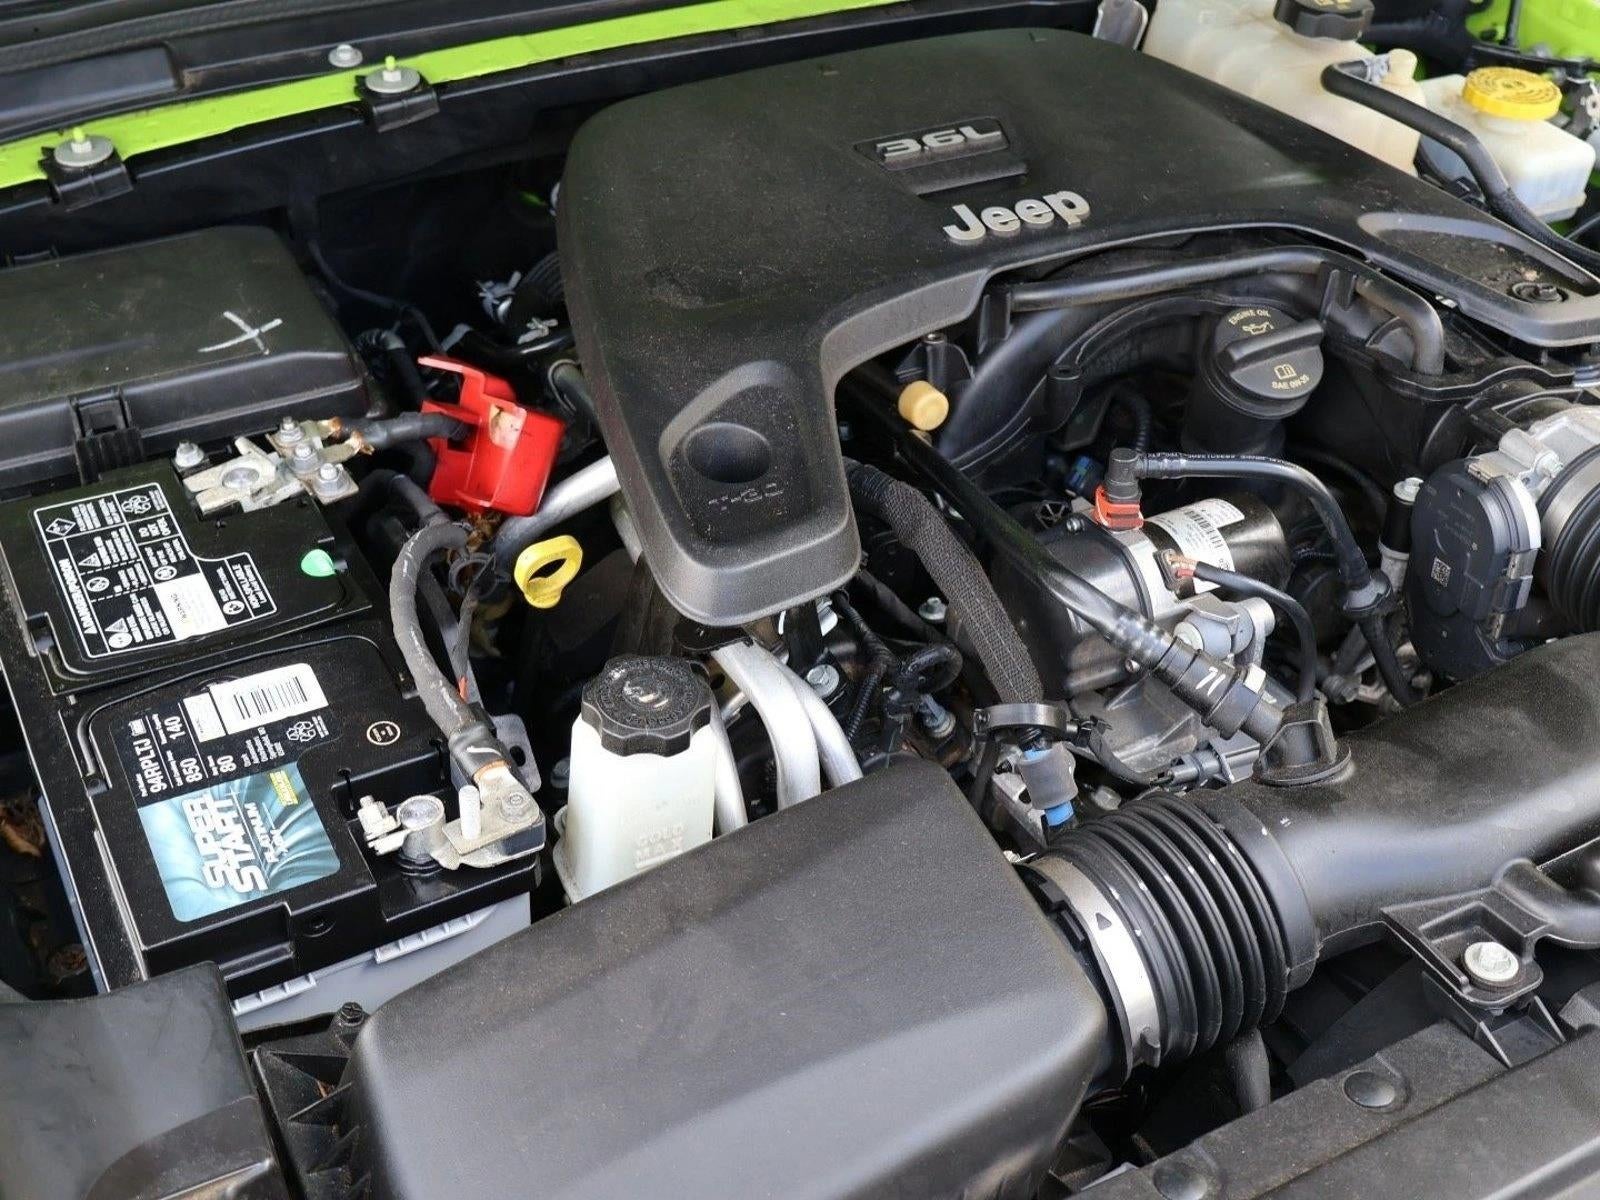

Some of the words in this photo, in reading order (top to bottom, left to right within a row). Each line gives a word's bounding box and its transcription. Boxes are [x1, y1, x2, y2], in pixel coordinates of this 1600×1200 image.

[876, 125, 1003, 161] 3.6L
[942, 190, 1090, 243] Jeep
[1228, 309, 1254, 325] ENGINE
[162, 714, 187, 740] 140
[132, 736, 168, 794] 94RPLTJ
[178, 756, 204, 783] 850
[215, 753, 239, 773] 80
[181, 796, 227, 889] SUPER
[203, 795, 267, 893] START
